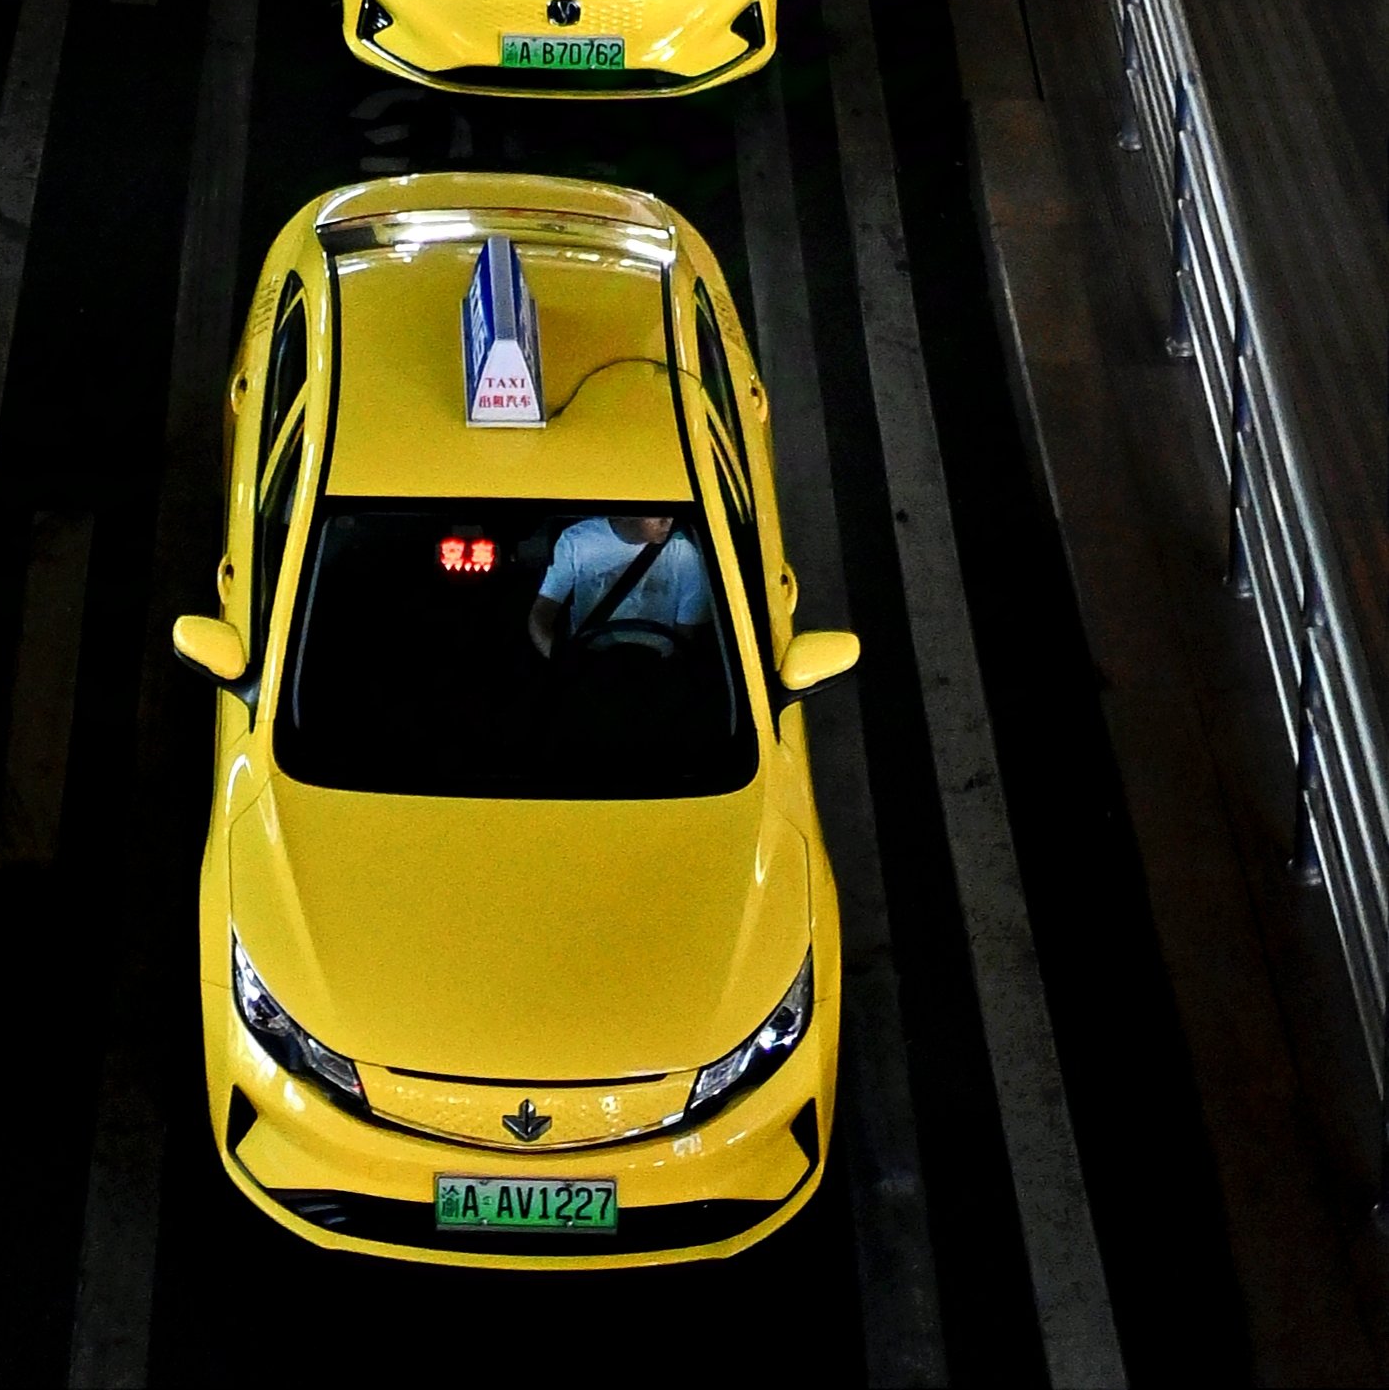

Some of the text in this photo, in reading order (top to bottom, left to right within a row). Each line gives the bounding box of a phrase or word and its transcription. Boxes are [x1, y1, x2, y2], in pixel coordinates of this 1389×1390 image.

[485, 377, 526, 389] TAXI
[479, 394, 531, 409] 出租汽车
